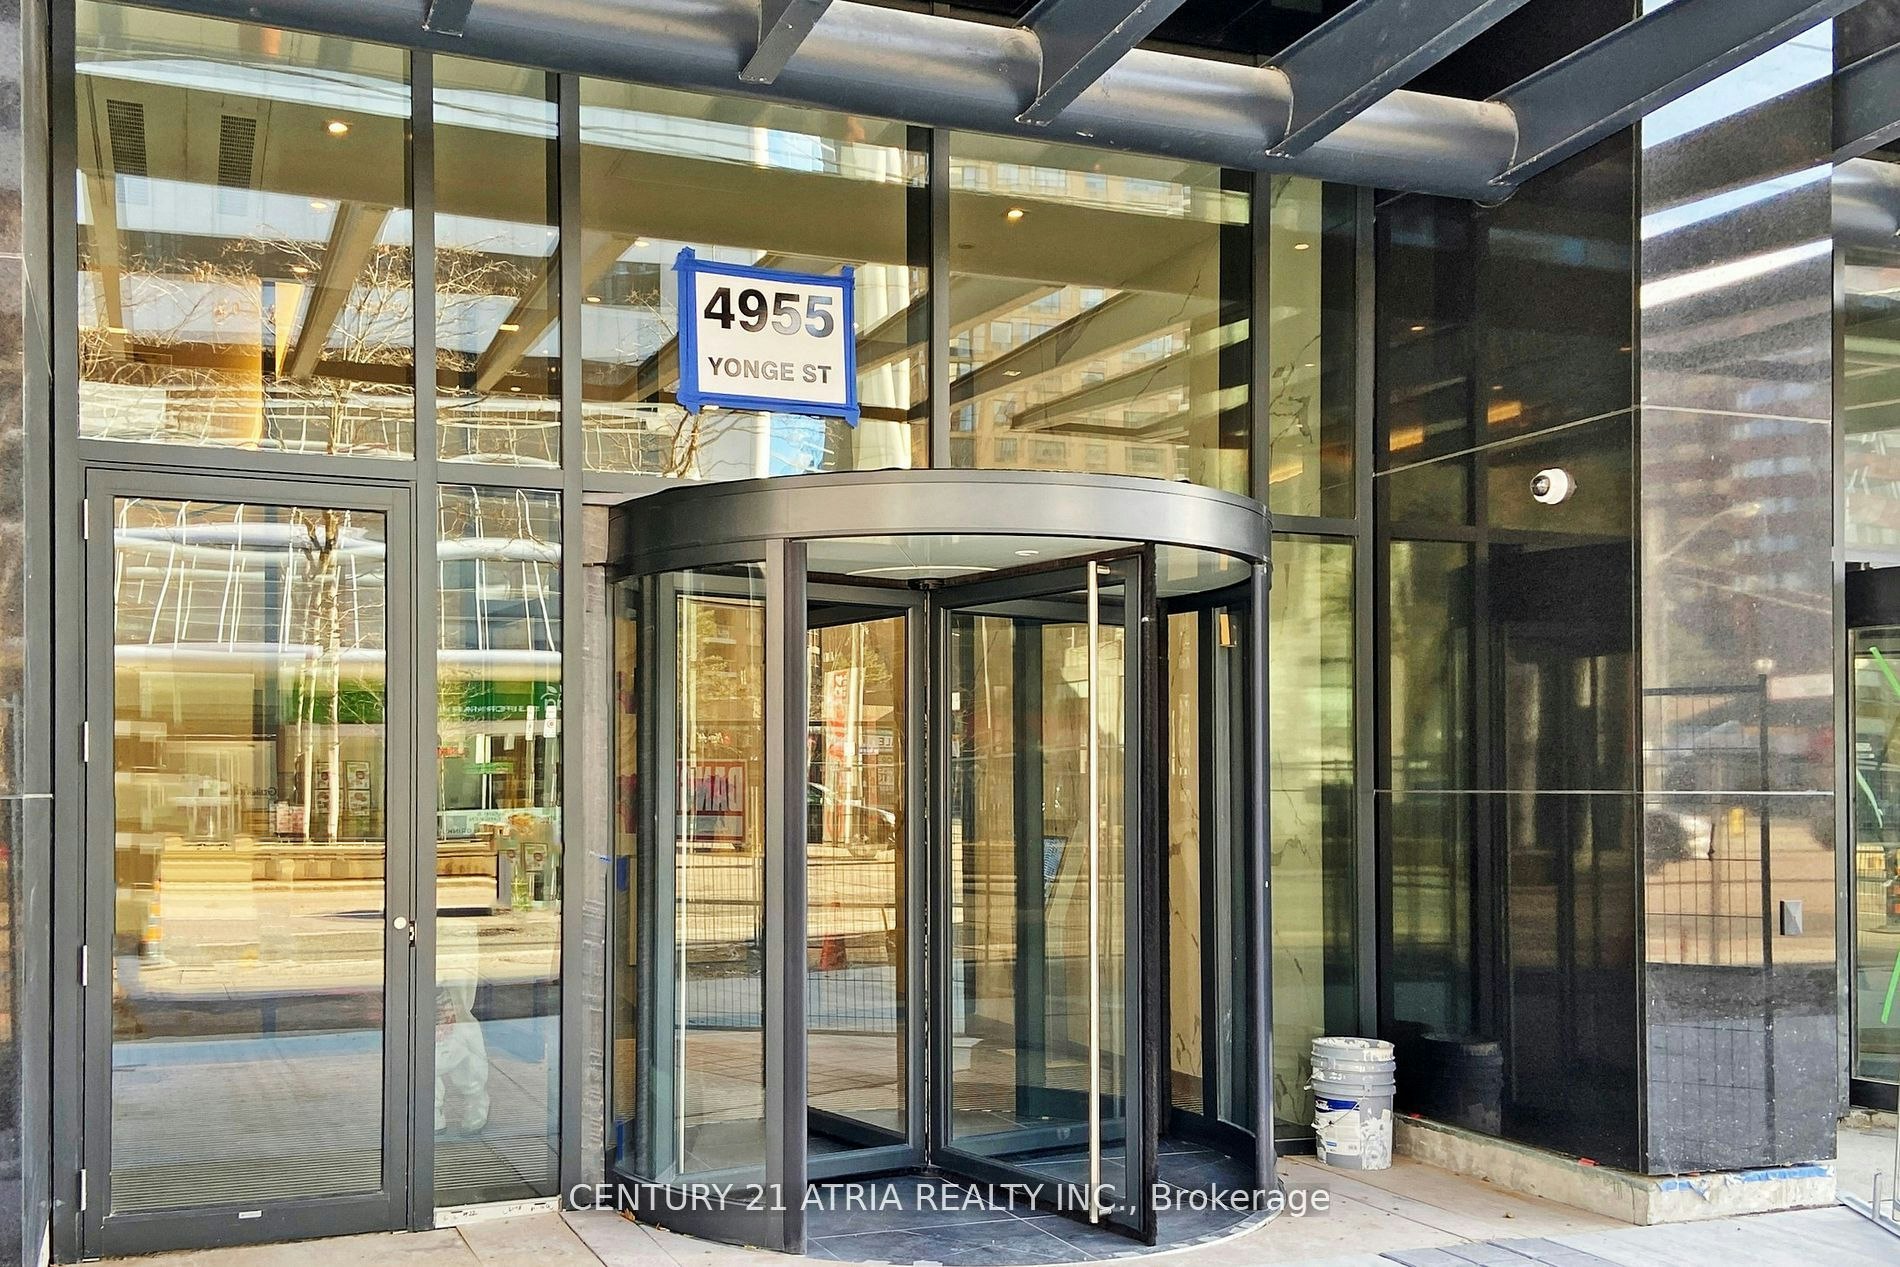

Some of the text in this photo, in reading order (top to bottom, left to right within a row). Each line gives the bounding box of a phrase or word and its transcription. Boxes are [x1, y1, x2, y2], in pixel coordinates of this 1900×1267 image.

[704, 286, 834, 338] 4955
[708, 357, 832, 384] YONGE ST
